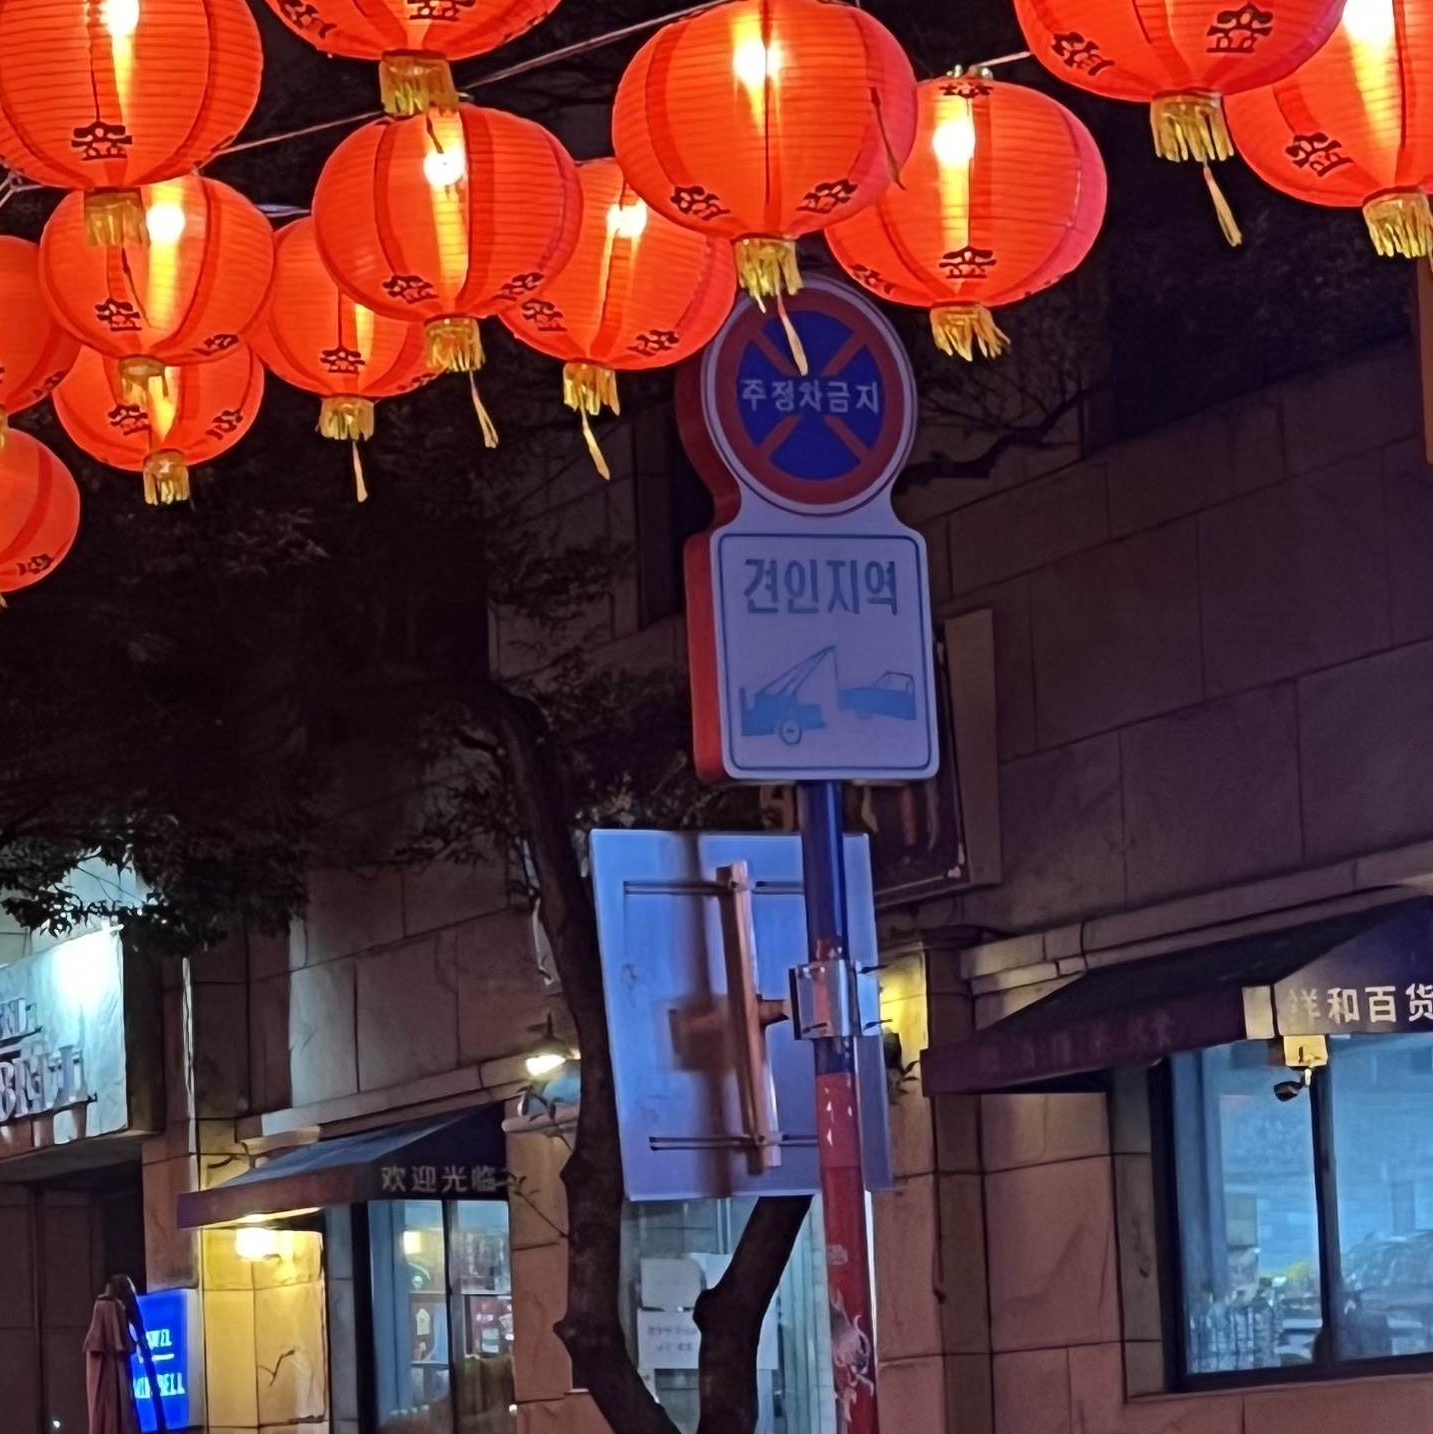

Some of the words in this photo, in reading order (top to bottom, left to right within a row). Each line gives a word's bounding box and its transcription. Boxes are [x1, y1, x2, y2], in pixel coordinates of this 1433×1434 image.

[740, 377, 880, 416] 주정차금지
[743, 556, 899, 617] 견인지역
[381, 1164, 498, 1193] 欢迎光临
